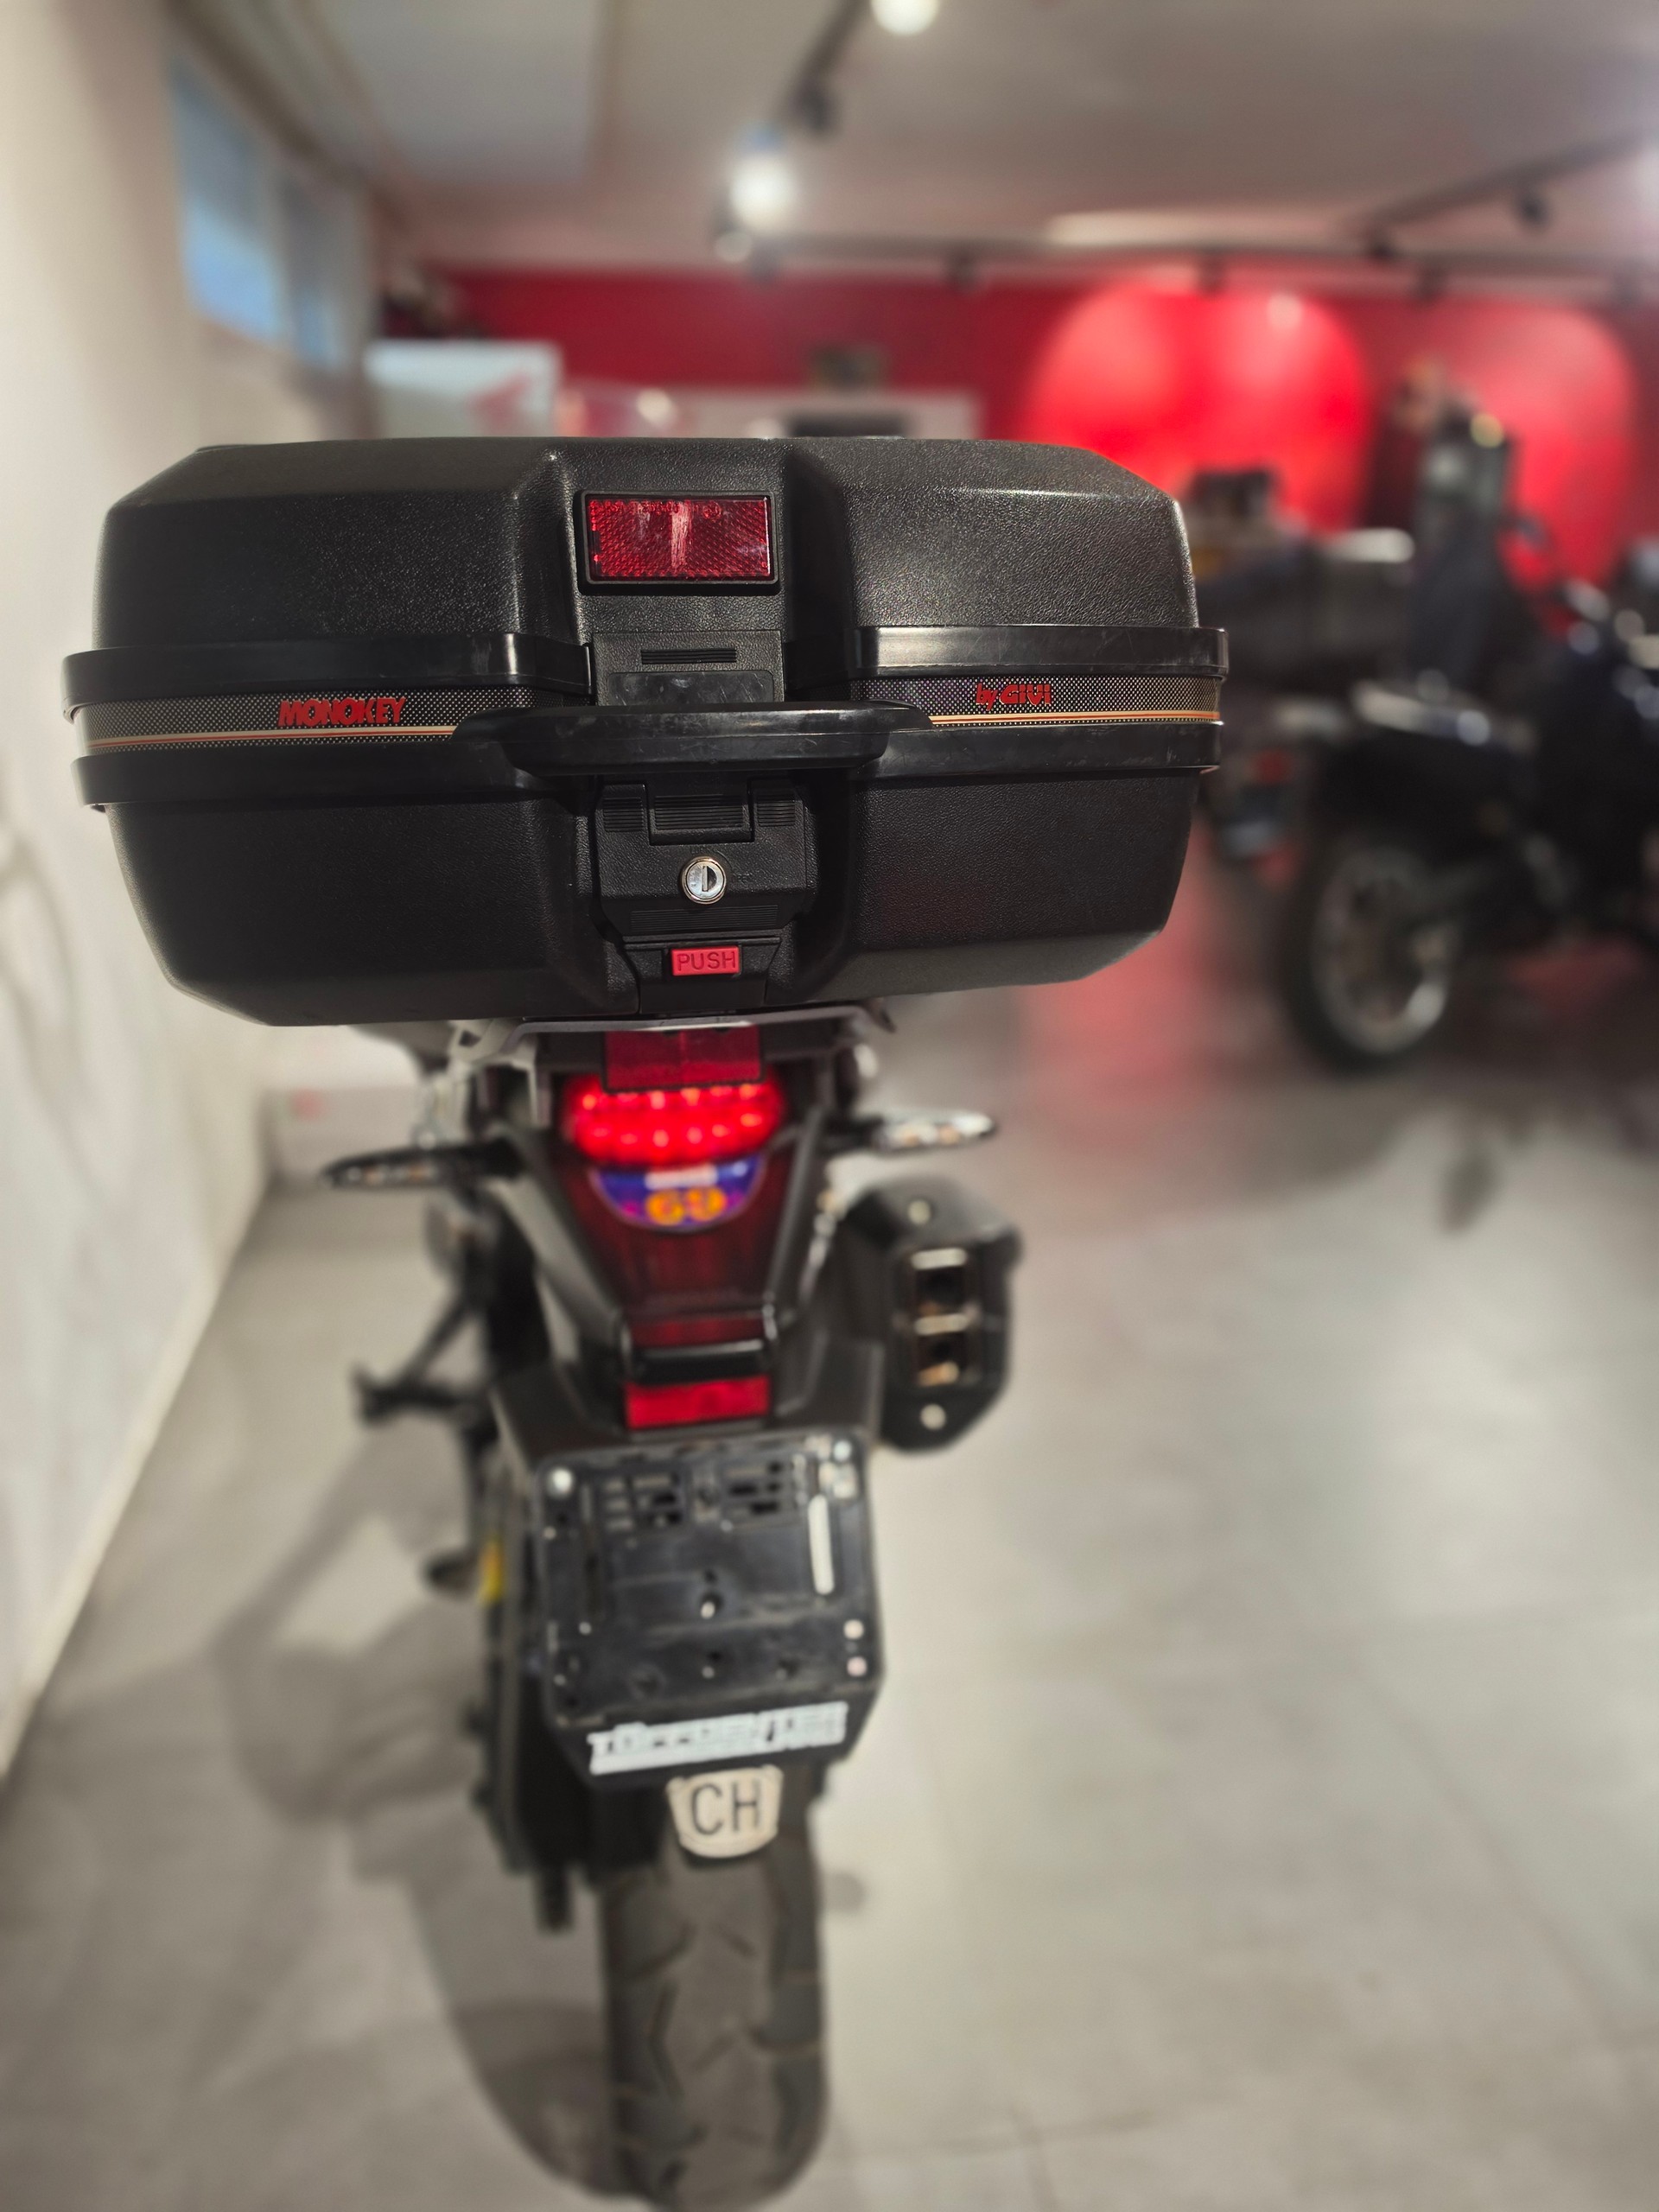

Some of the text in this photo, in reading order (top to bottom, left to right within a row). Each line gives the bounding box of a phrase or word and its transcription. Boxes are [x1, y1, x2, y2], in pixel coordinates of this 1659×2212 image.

[277, 696, 406, 727] MONOKEY
[976, 683, 1051, 711] by GIVI
[677, 951, 735, 971] PUSH
[690, 1778, 761, 1836] CH
